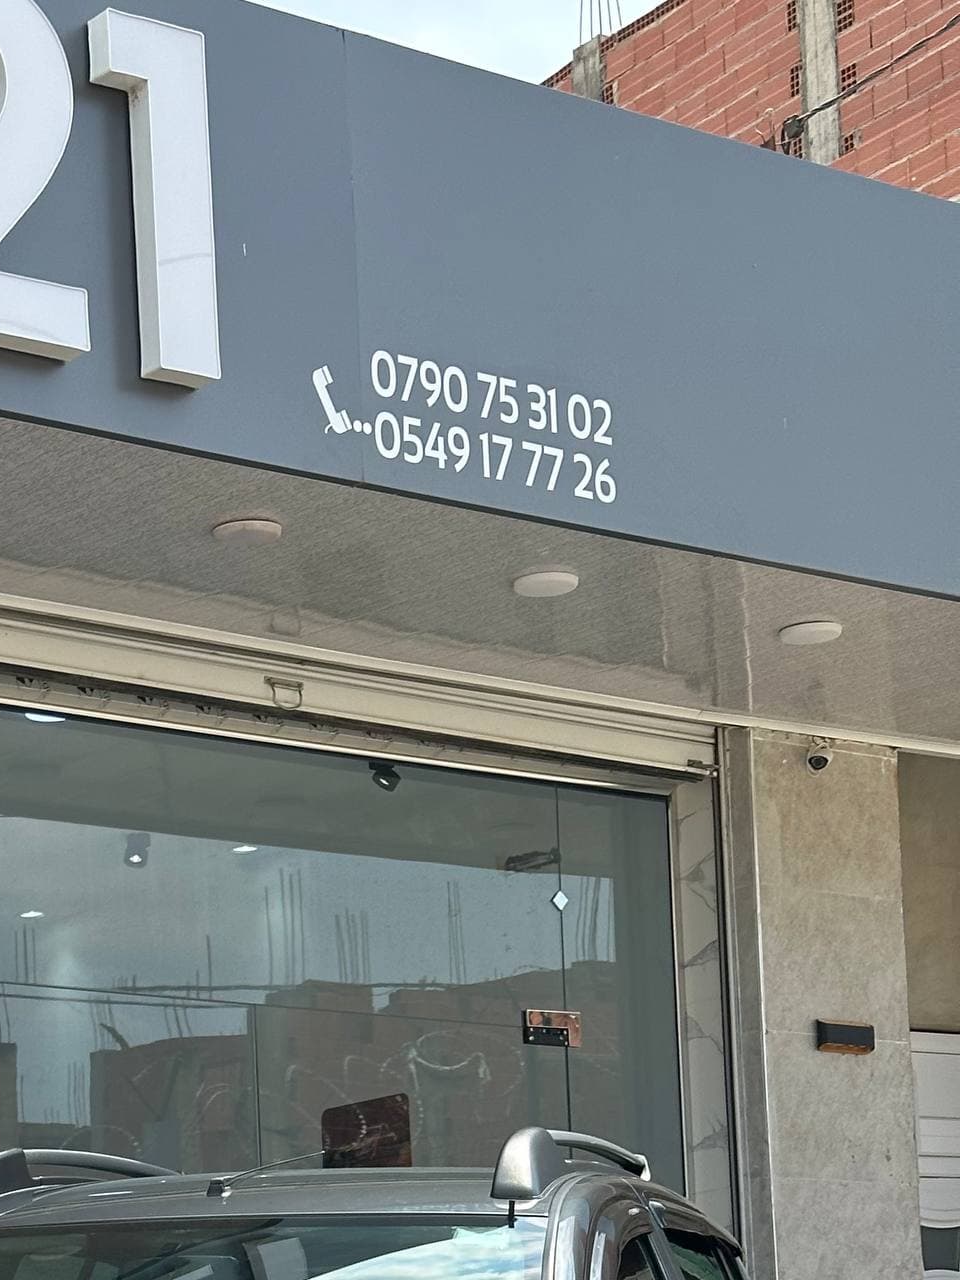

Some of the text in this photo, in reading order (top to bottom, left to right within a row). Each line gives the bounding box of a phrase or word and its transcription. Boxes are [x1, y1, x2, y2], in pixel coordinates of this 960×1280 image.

[370, 350, 613, 446] 0790 75 31 02
[374, 411, 617, 504] 0549 17 77 26
